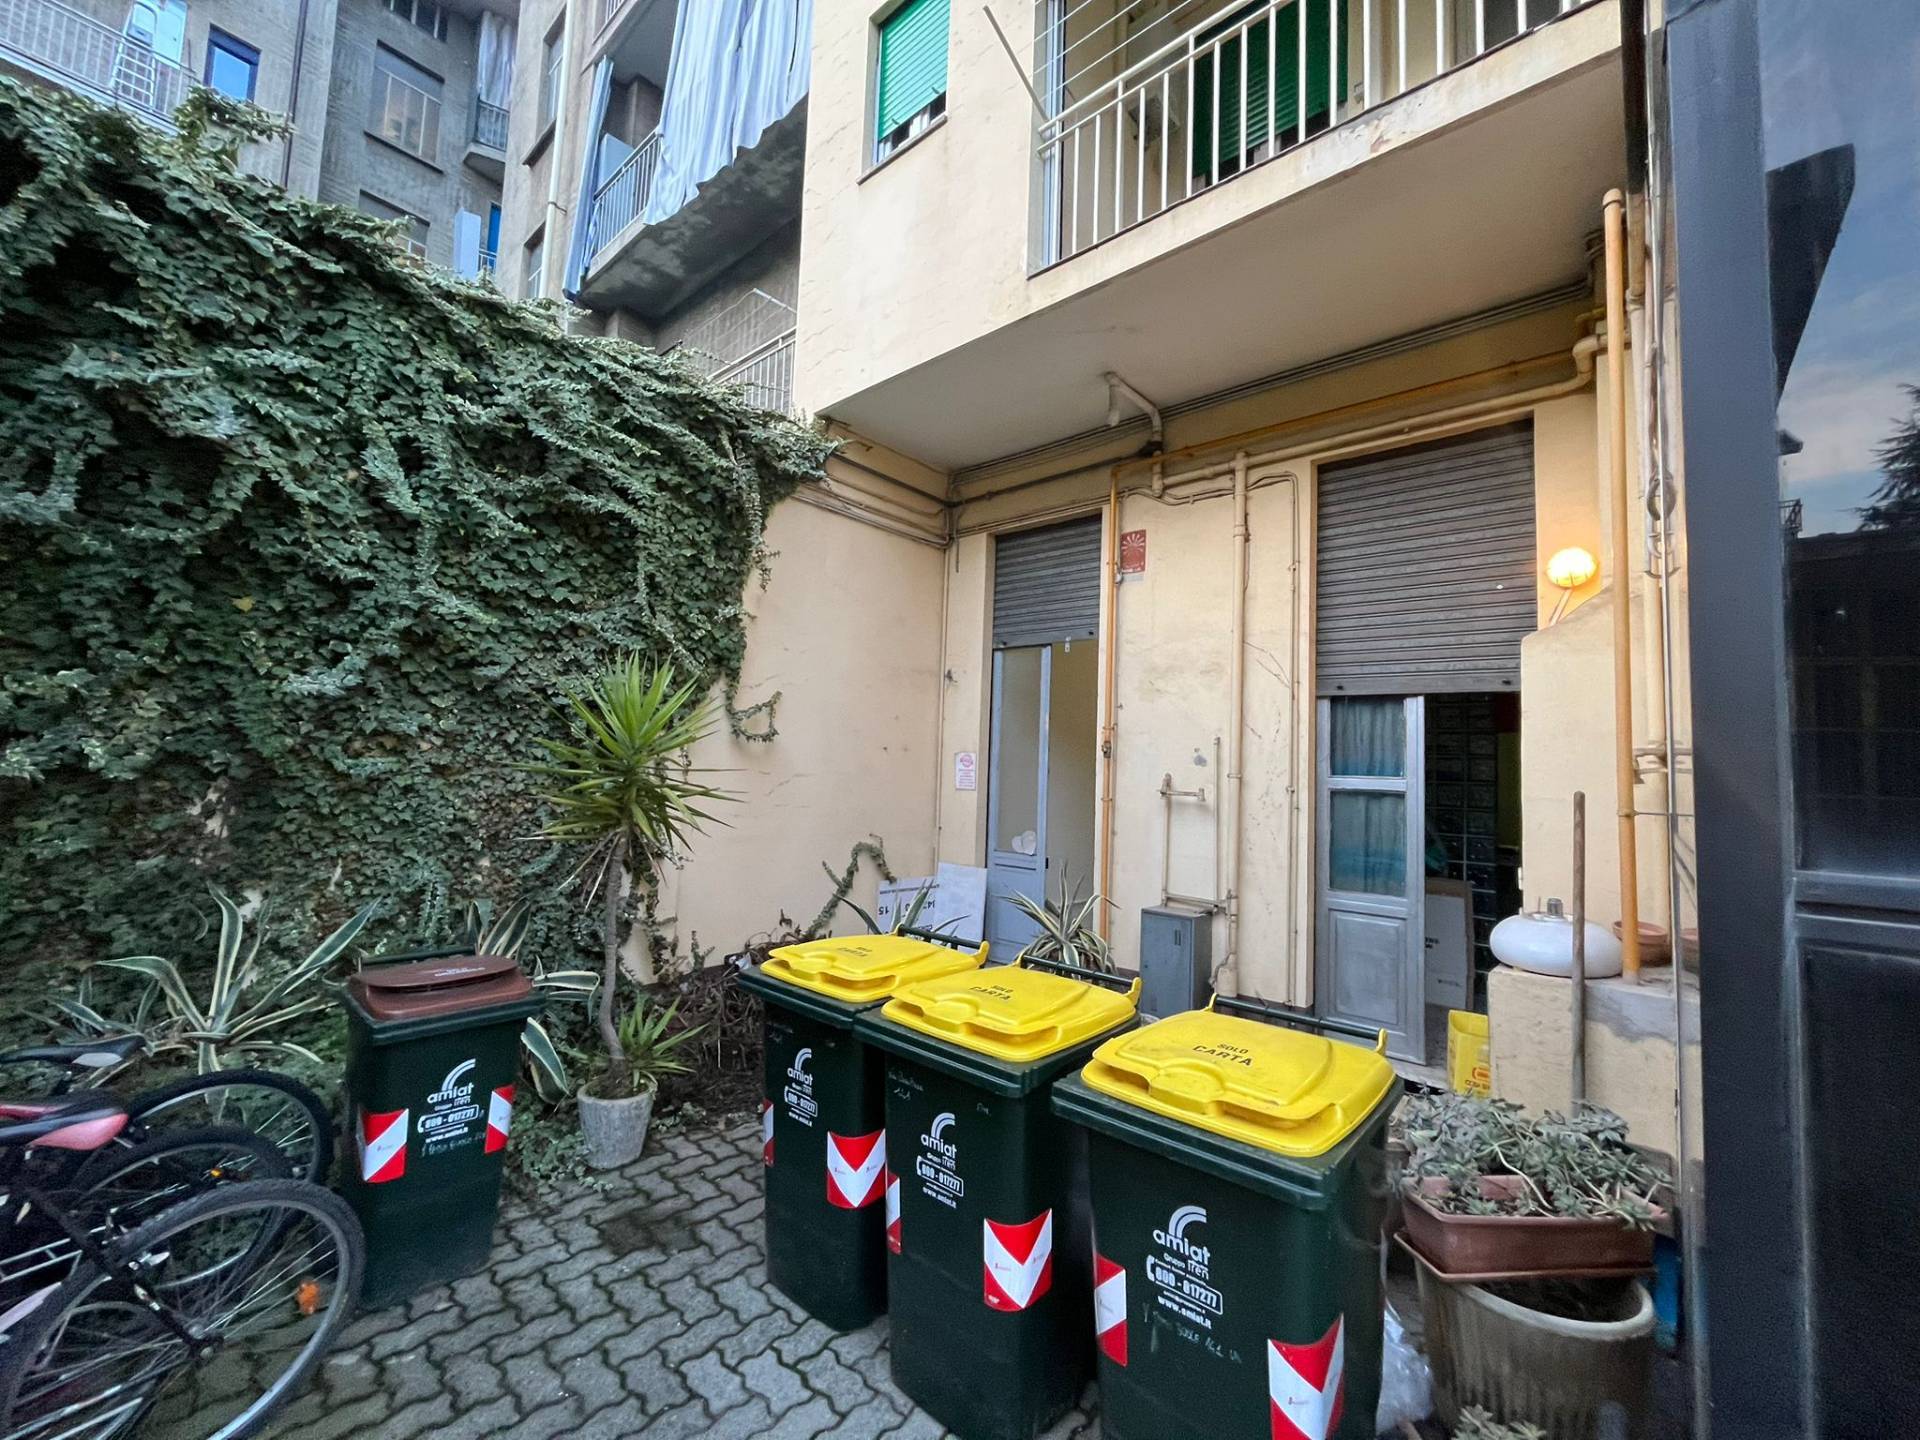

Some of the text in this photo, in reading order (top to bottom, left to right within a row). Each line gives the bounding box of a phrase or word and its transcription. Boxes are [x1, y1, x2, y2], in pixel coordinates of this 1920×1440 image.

[1192, 1045, 1252, 1066] CARTA
[1217, 1043, 1249, 1055] SOLO
[786, 1067, 813, 1087] amiat
[427, 1082, 474, 1104] amiat
[920, 1134, 957, 1159] amiat
[1152, 1229, 1211, 1266] amiat
